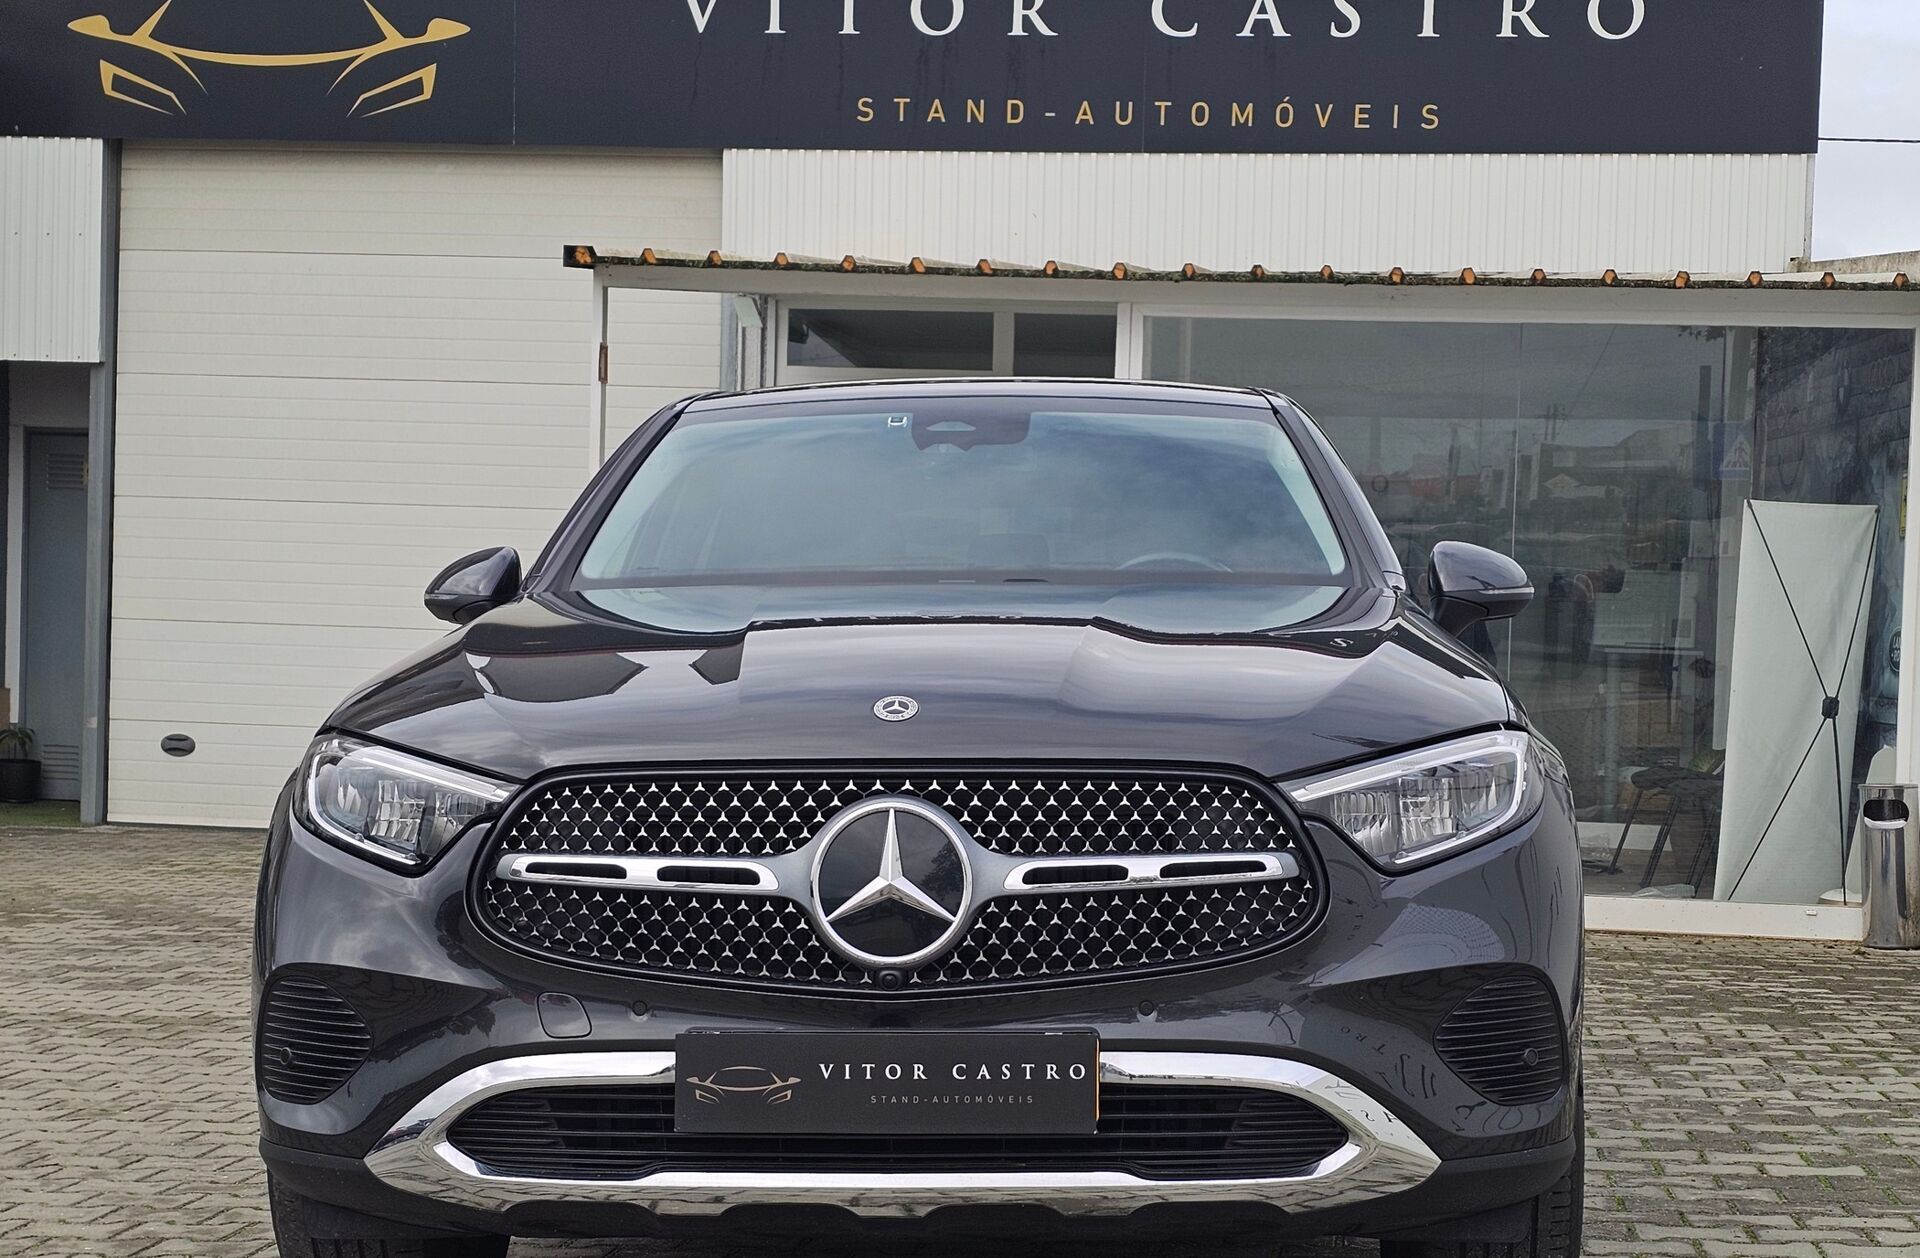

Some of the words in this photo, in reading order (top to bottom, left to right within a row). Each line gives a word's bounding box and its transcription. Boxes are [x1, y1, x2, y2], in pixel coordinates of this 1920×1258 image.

[856, 97, 1440, 130] STAND-AUTOMÓVEIS
[818, 1063, 928, 1080] VITOR
[952, 1063, 1087, 1080] CASTRO
[870, 1094, 1034, 1104] STAND-AUTOMÓVEIS
